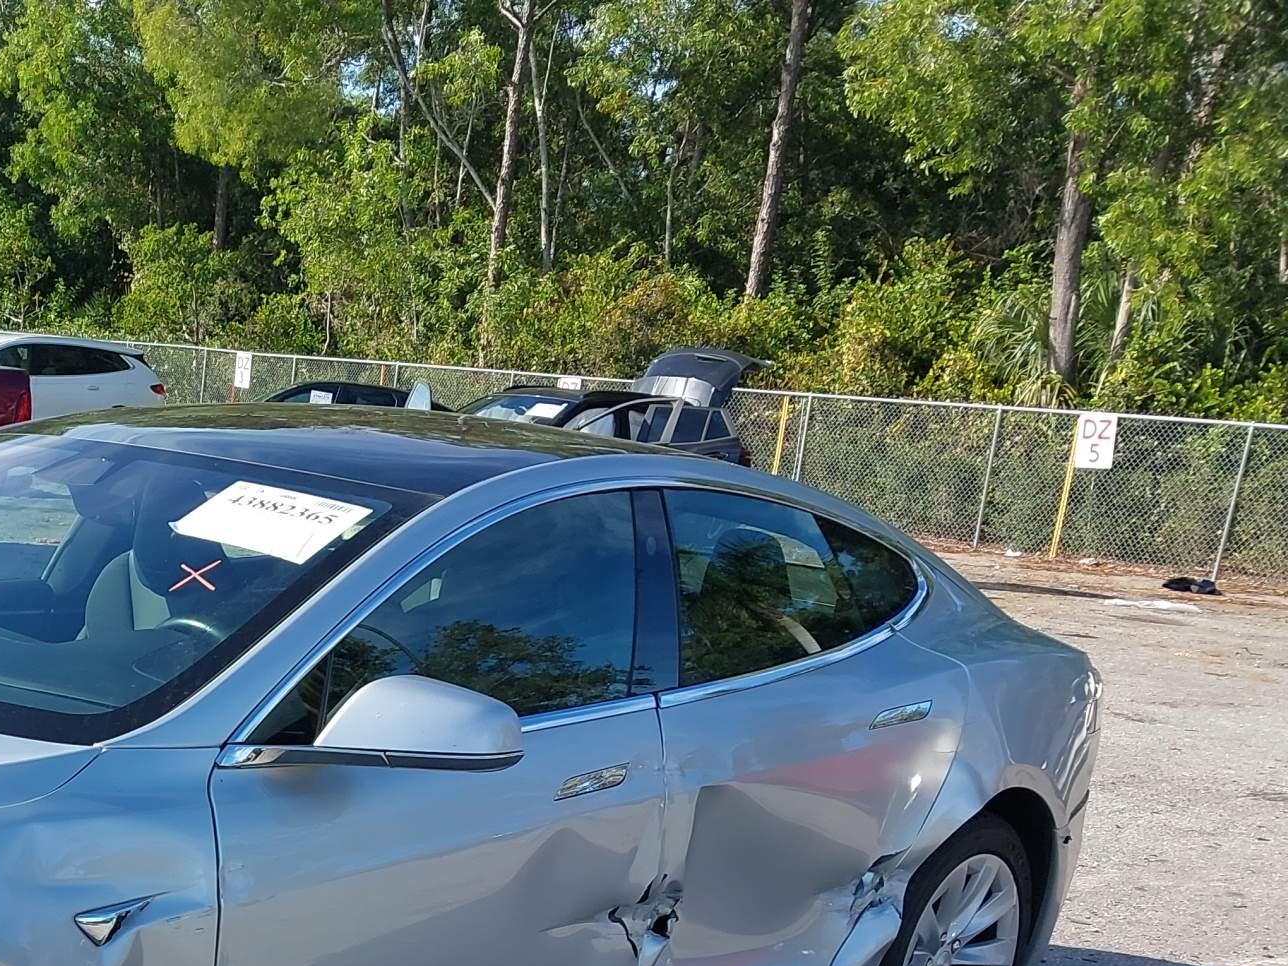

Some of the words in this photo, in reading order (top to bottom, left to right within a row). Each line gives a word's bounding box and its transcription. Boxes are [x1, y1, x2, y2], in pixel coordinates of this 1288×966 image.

[1082, 419, 1113, 440] DZ
[1088, 443, 1100, 463] 5
[228, 495, 339, 525] 43882365
